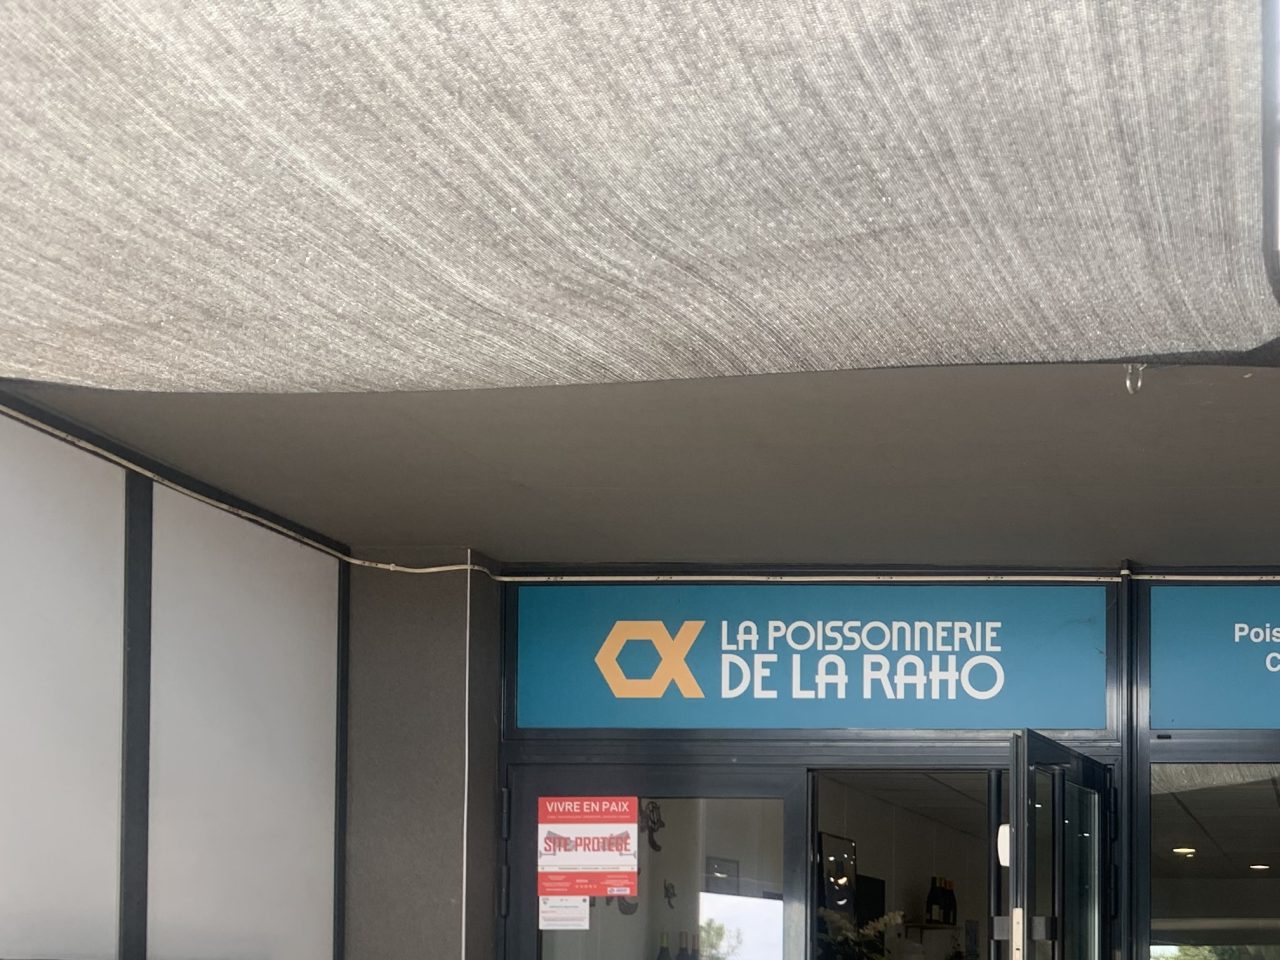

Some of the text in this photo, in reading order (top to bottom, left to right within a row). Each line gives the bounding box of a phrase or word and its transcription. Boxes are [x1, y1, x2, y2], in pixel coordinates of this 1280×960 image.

[721, 620, 1002, 652] LA POISSONNERIE
[721, 653, 1005, 700] DE LA RAHO
[546, 801, 629, 812] VIVRE EN PAIX
[544, 836, 572, 852] SITE
